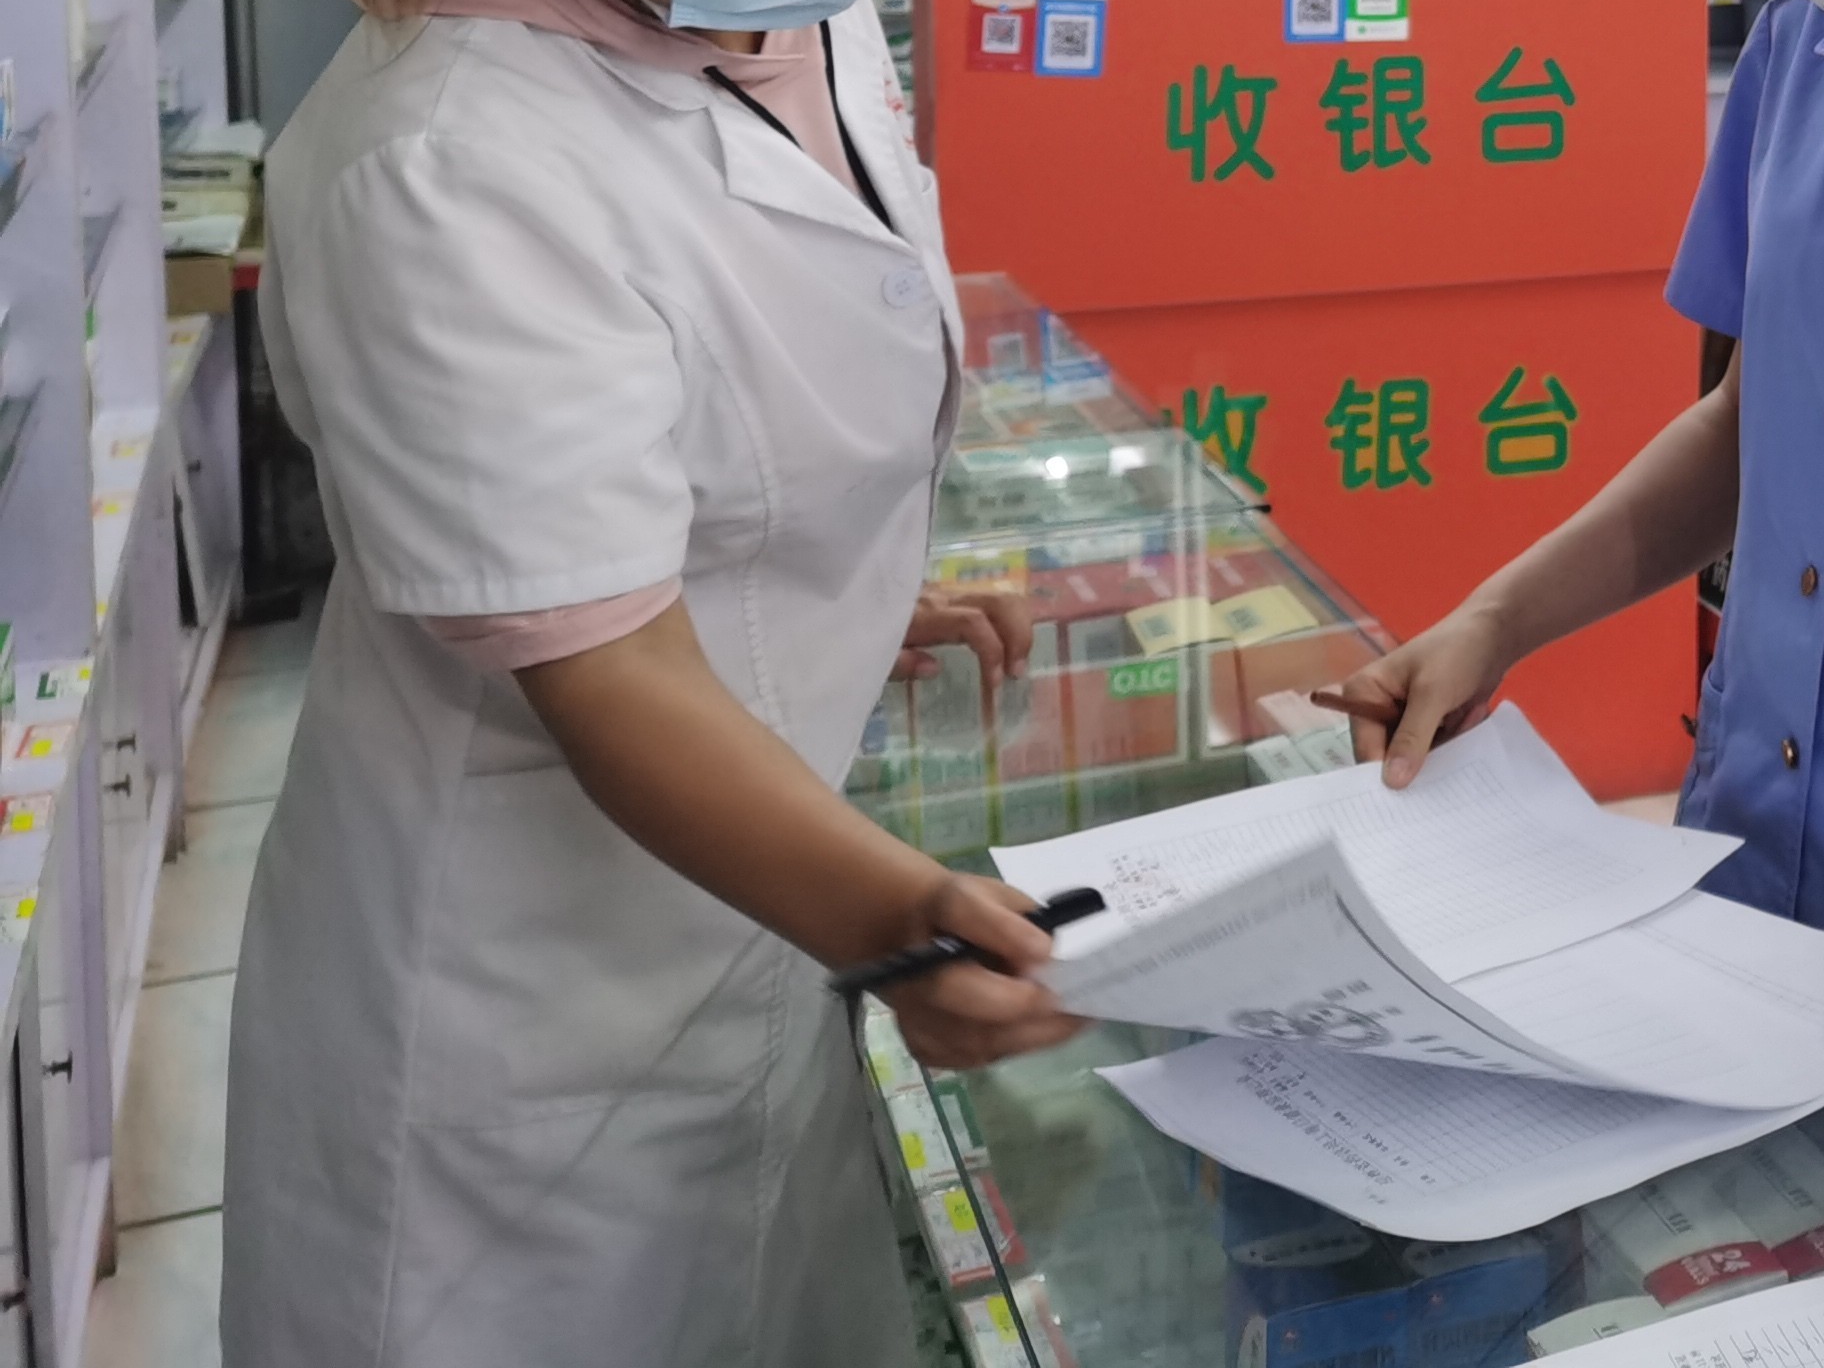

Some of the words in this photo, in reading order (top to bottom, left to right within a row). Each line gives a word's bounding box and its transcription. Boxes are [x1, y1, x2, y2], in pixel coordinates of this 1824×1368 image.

[1165, 47, 1576, 182] 收银台
[1161, 366, 1577, 494] 收银台
